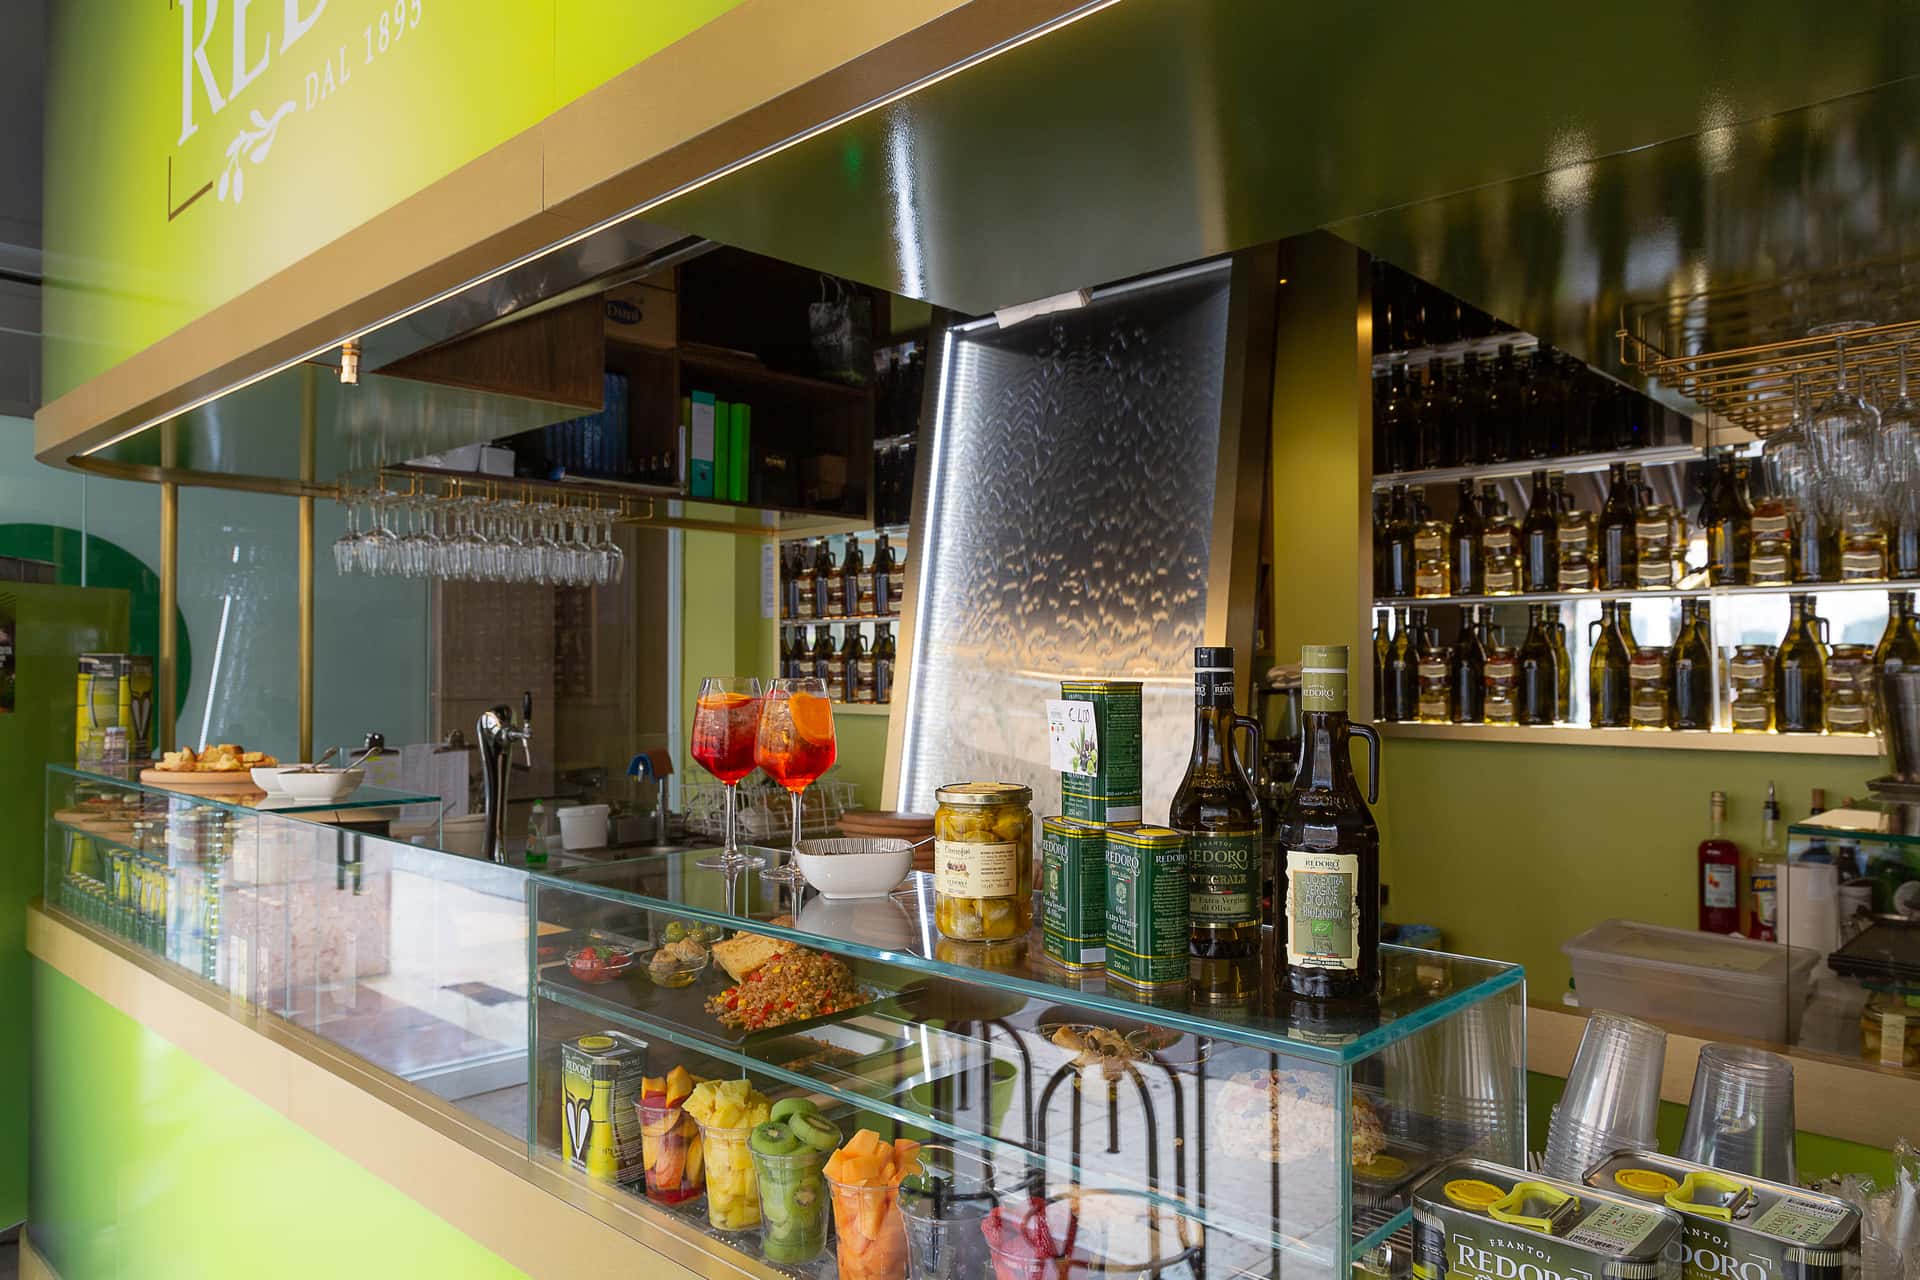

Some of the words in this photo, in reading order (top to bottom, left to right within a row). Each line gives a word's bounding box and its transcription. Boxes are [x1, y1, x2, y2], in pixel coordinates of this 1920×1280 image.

[304, 46, 350, 112] DAL
[363, 0, 422, 64] 1895
[1105, 850, 1140, 877] REDORO
[1456, 1243, 1580, 1280] REDOR
[1488, 1238, 1552, 1263] FRANTOI
